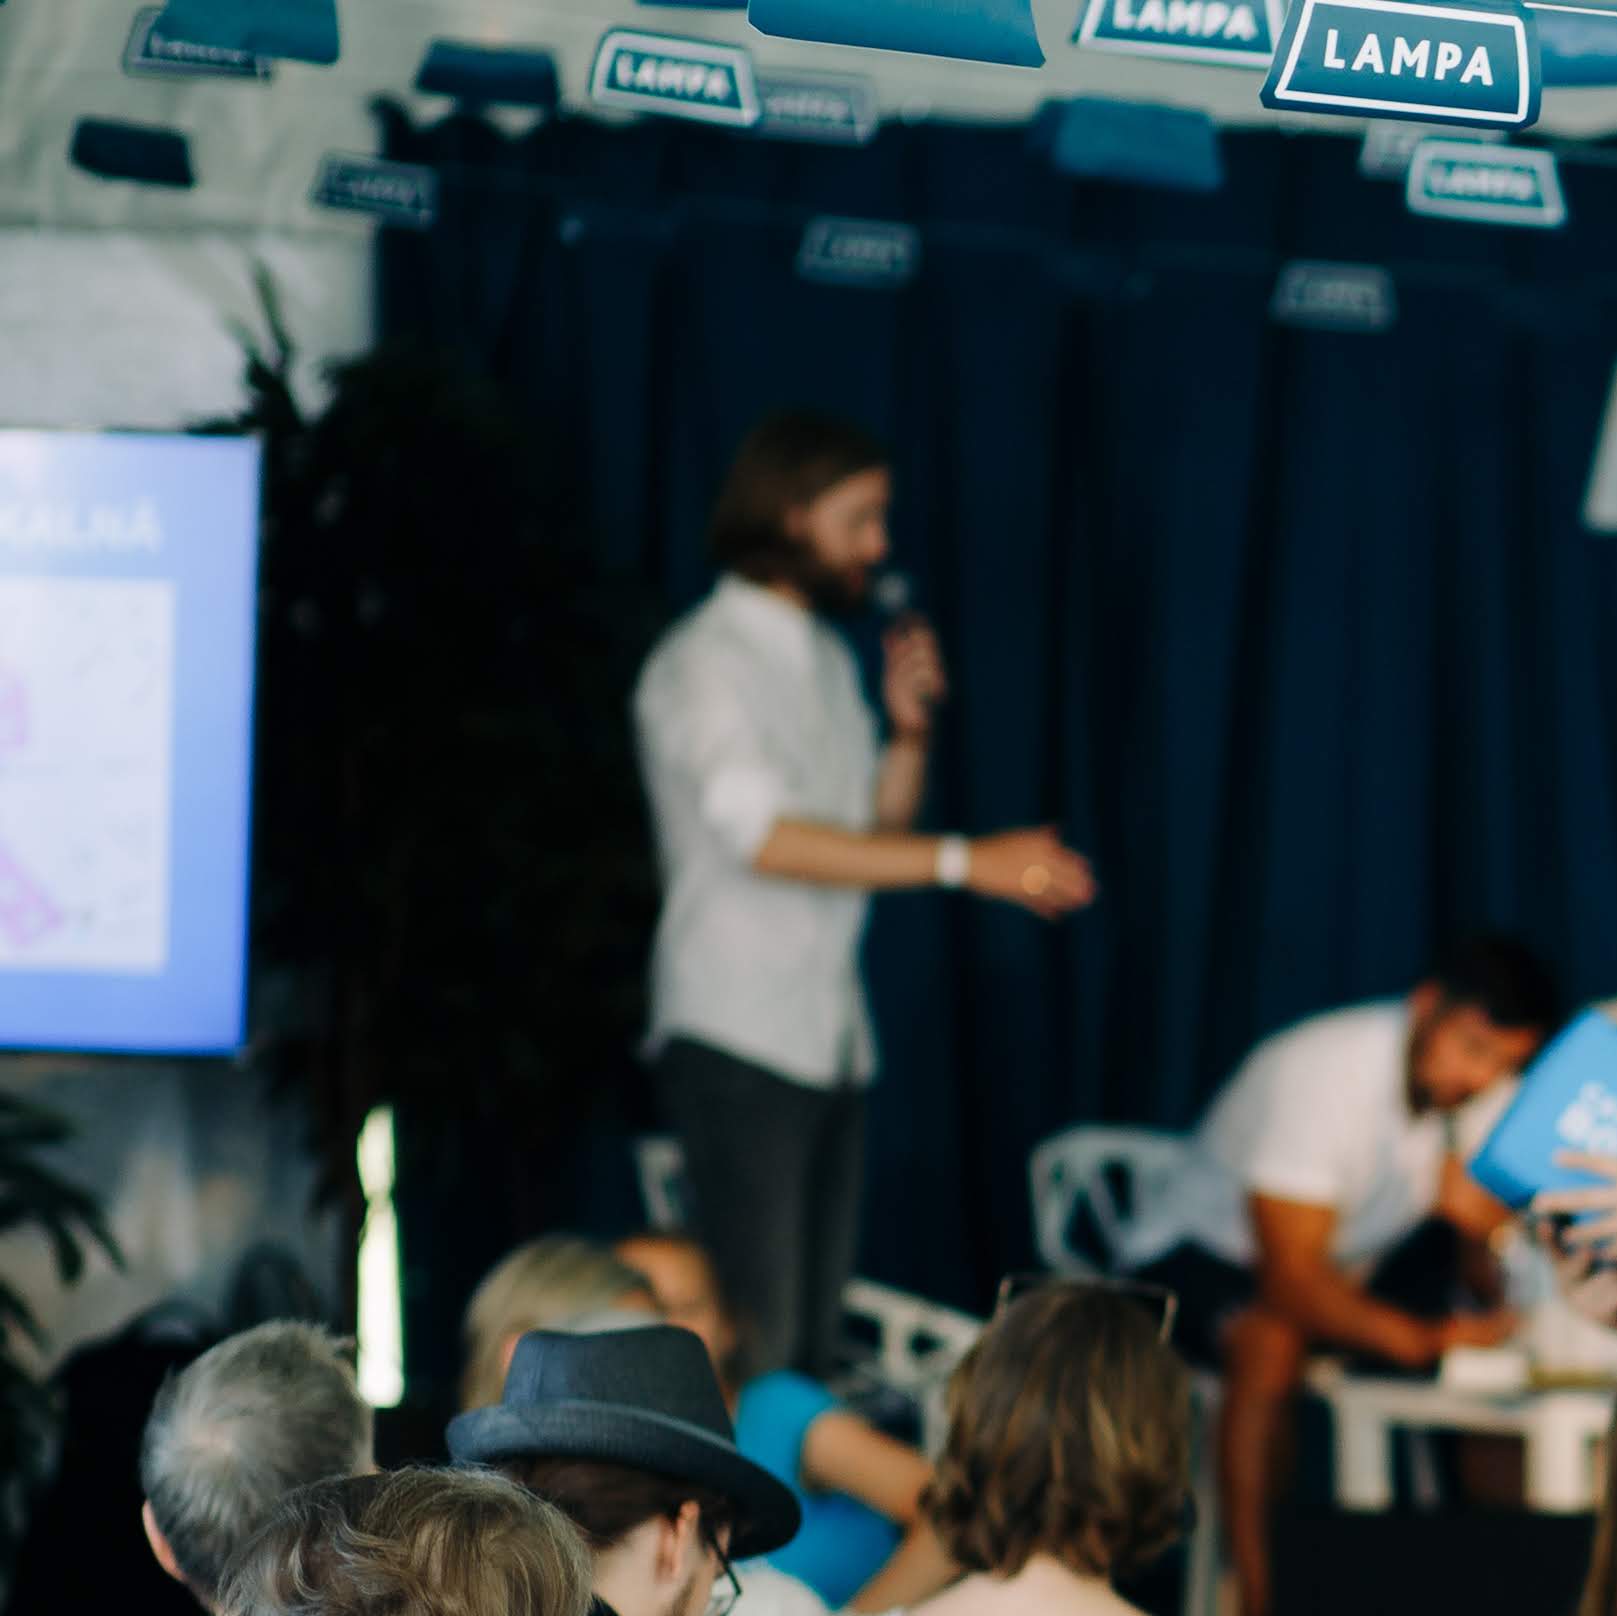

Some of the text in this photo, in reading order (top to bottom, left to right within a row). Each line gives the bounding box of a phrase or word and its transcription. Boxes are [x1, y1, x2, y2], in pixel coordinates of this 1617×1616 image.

[1113, 0, 1259, 41] LAMPA
[615, 52, 731, 100] LAMPA
[1323, 28, 1494, 87] LAMPA
